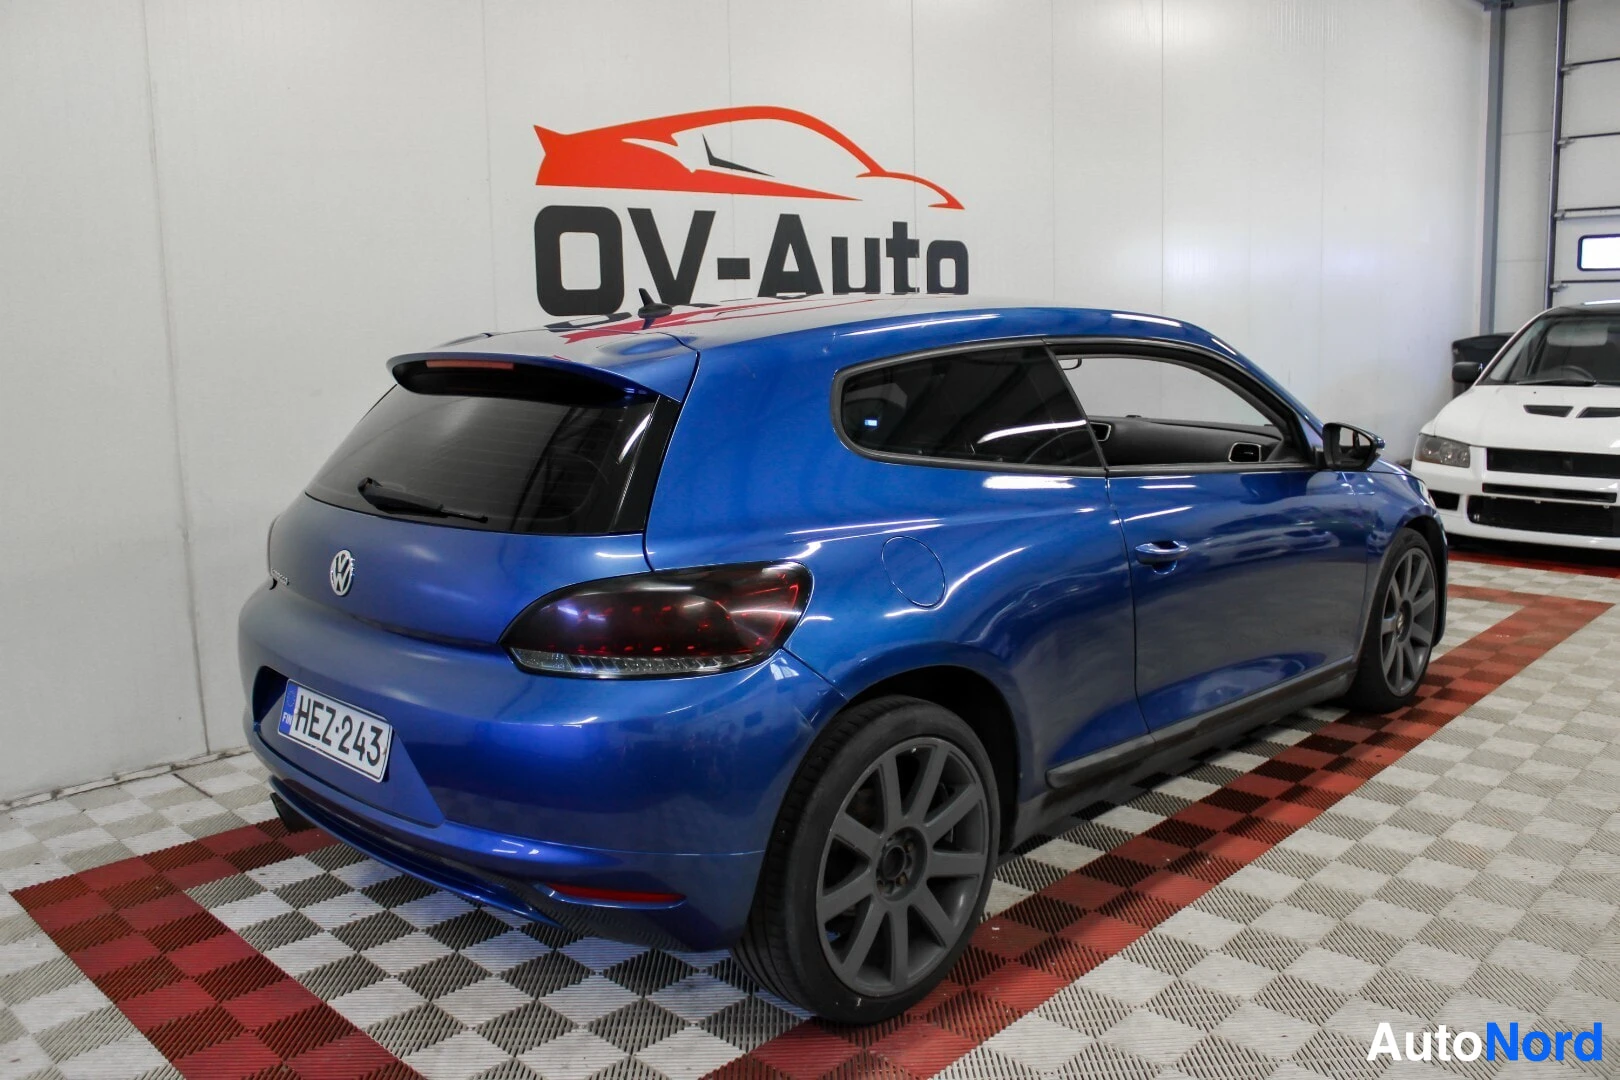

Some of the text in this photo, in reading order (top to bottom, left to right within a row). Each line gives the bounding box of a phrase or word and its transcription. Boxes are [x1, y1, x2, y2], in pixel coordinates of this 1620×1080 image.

[534, 205, 969, 317] OV-Auto
[282, 711, 293, 726] FIN
[295, 695, 383, 767] HEZ-243
